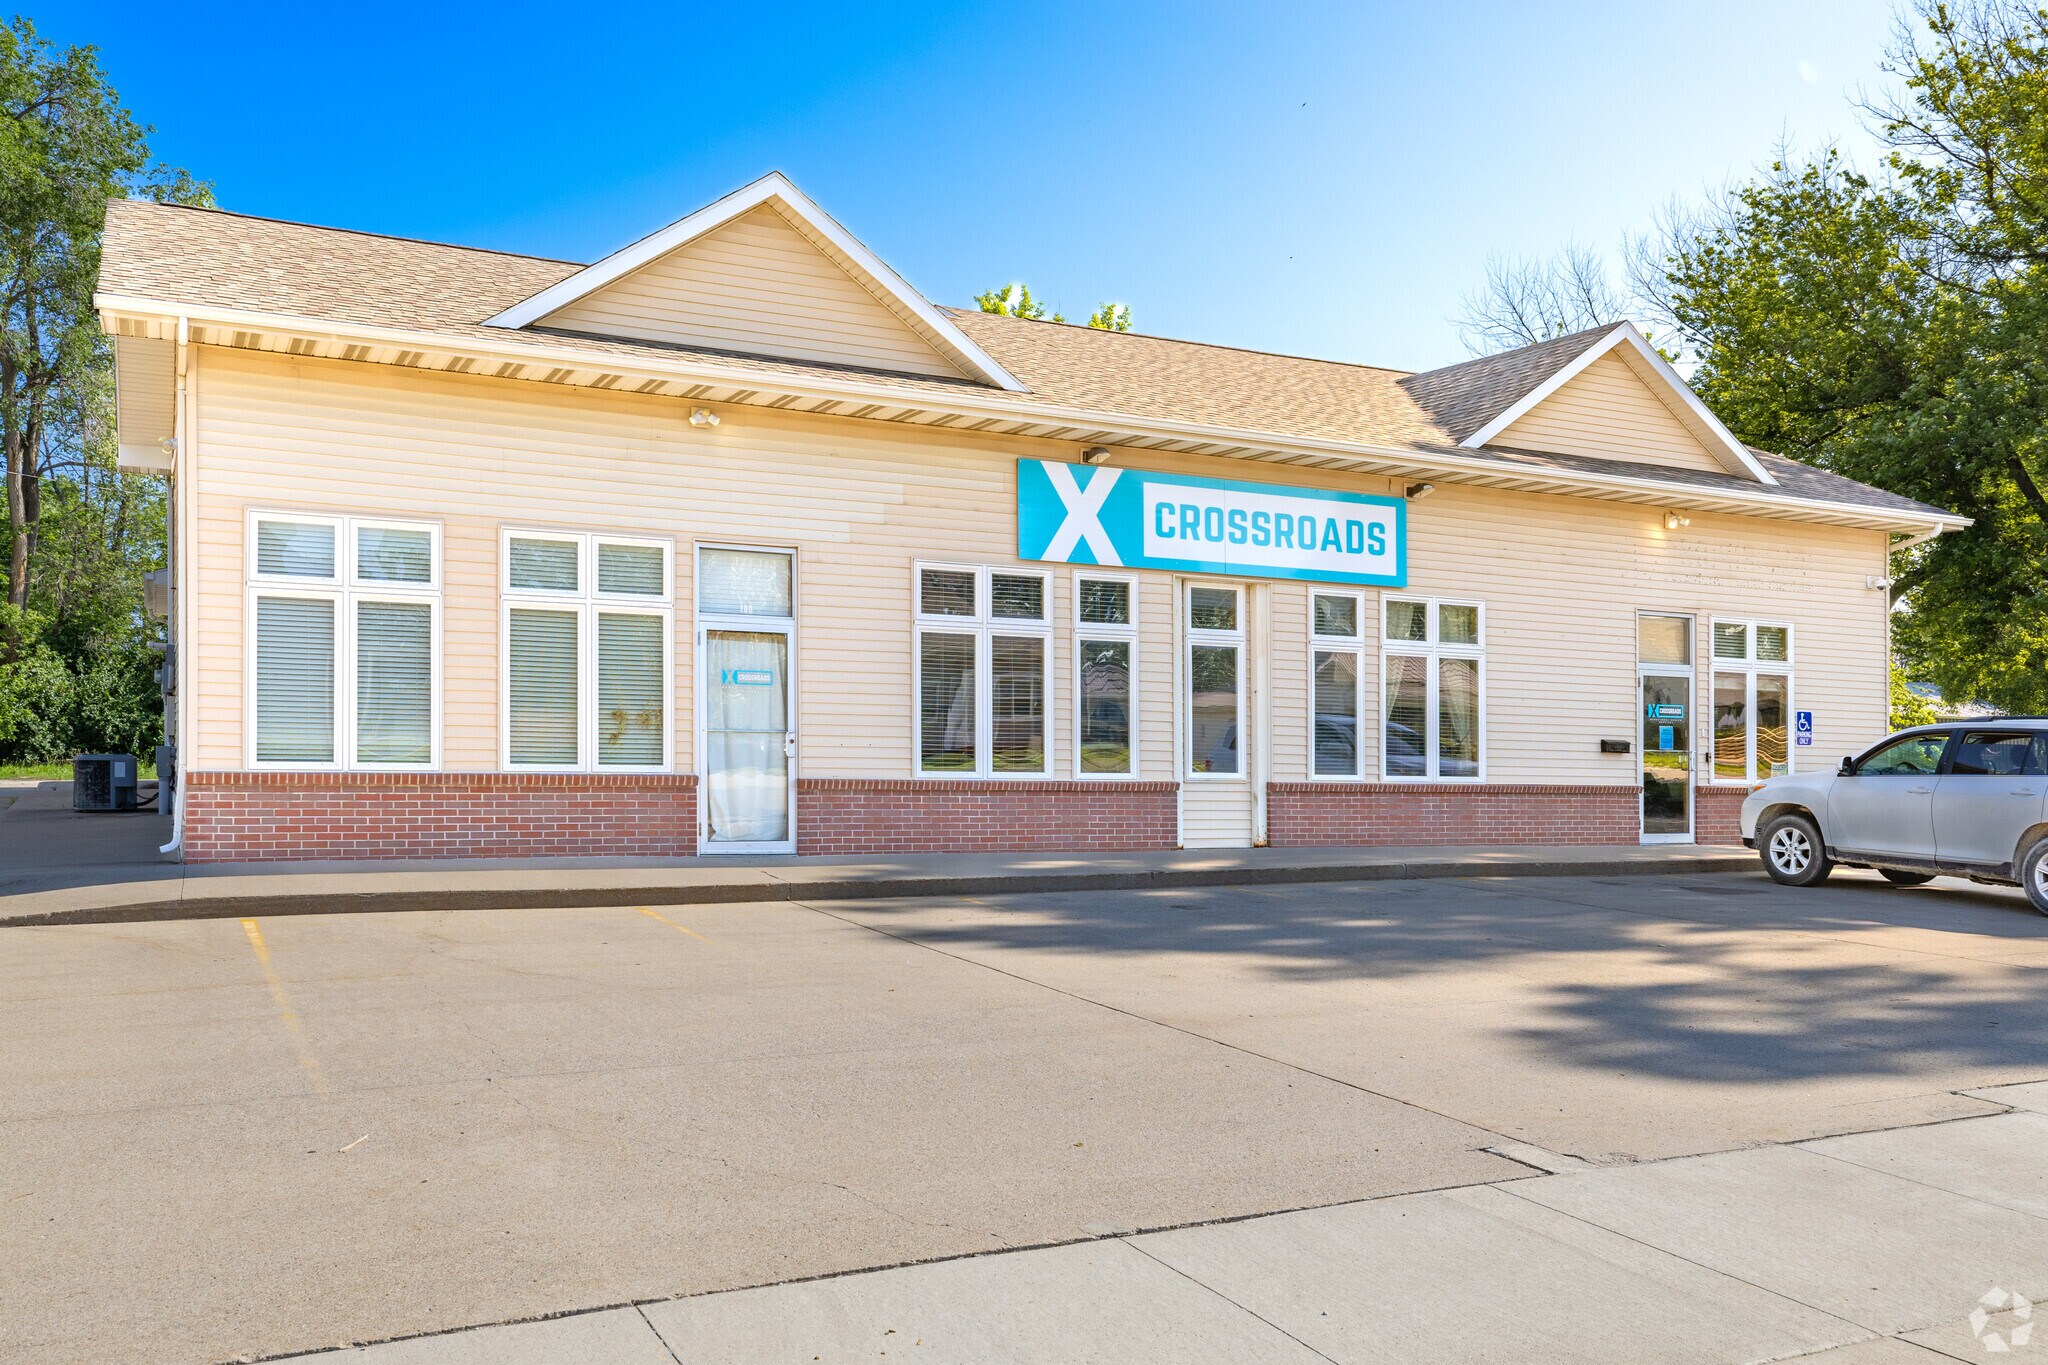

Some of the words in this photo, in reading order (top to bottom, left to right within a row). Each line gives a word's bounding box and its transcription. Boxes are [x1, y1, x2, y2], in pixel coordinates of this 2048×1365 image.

[1039, 460, 1125, 567] X
[1154, 501, 1386, 556] CROSSROADS
[1799, 737, 1809, 745] ONLY
